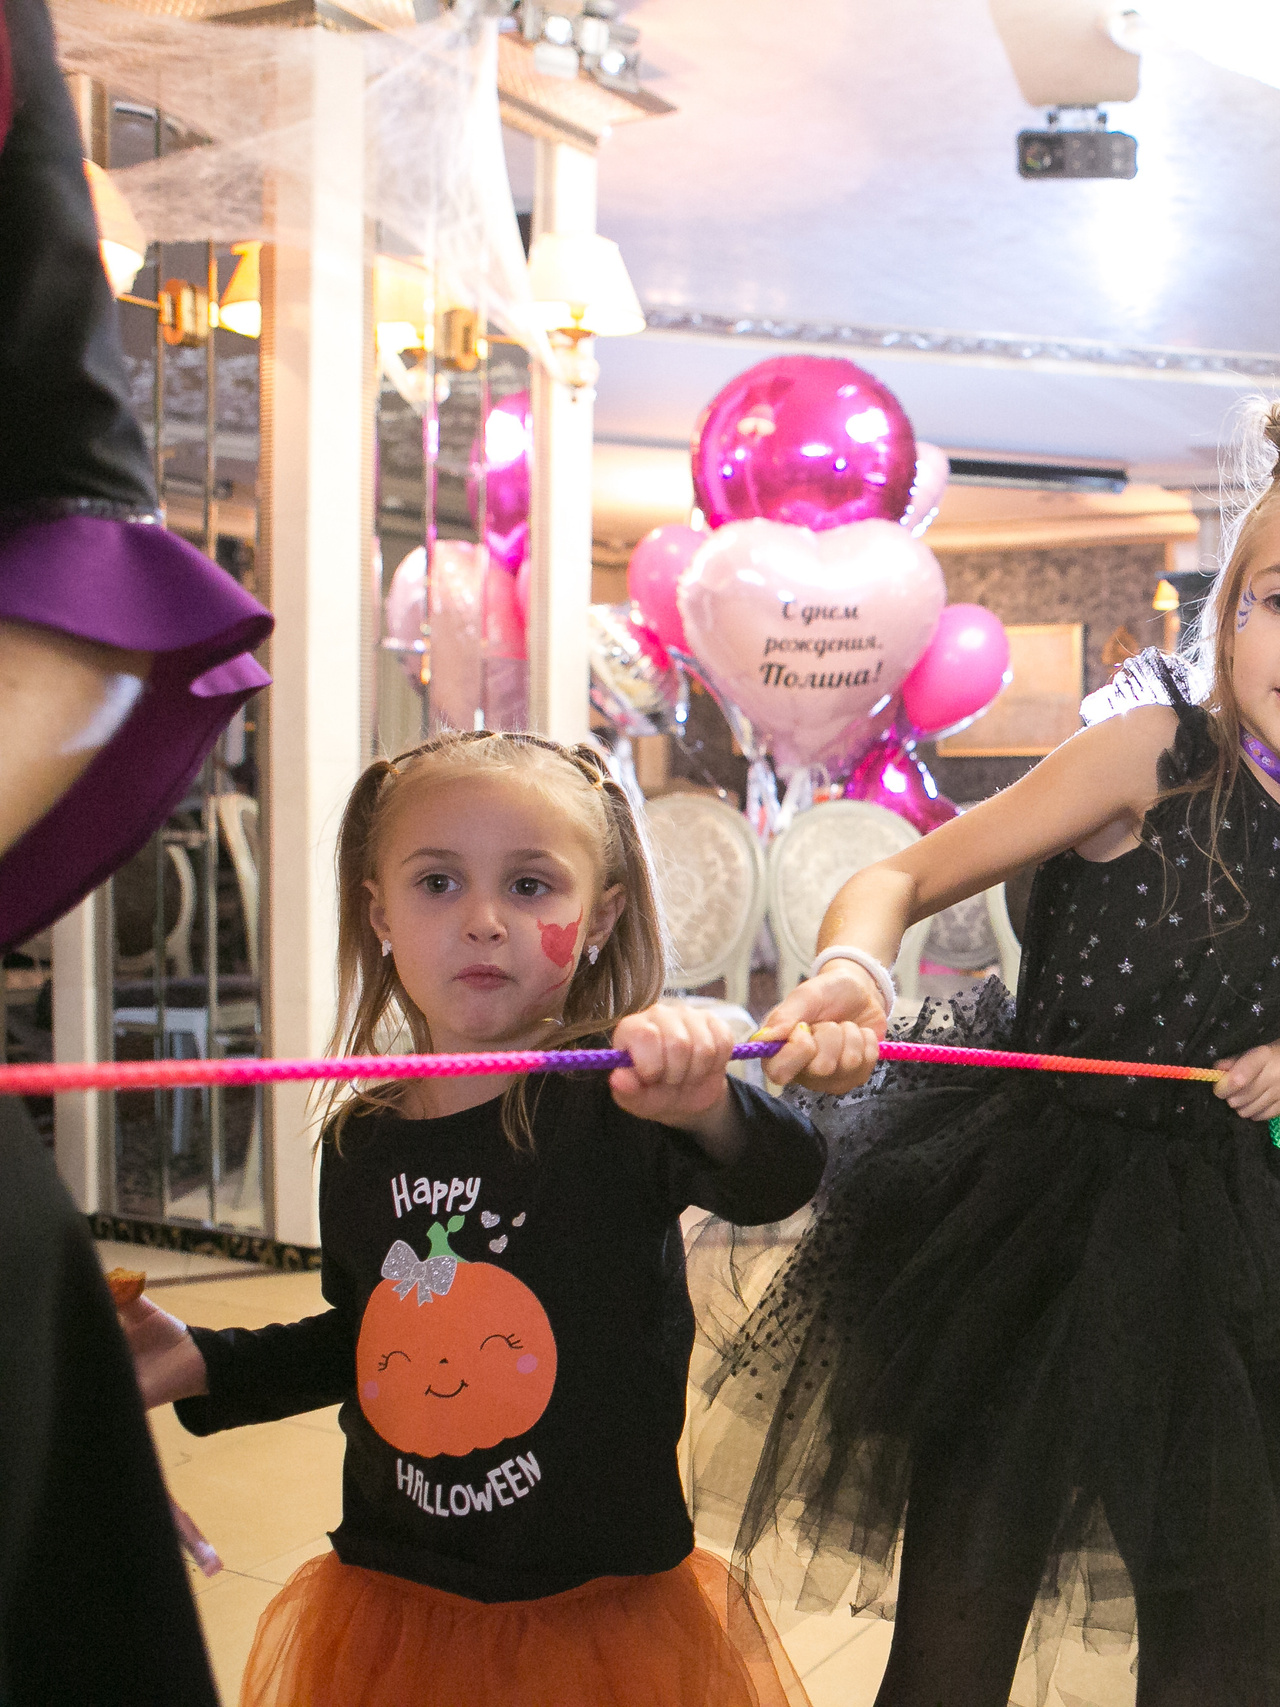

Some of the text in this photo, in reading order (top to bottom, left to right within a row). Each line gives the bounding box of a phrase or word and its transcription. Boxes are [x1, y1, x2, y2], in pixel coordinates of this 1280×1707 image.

[801, 606, 859, 626] днем
[759, 660, 884, 688] Полина!
[391, 1172, 481, 1219] Happy
[396, 1451, 542, 1517] HALLOWEEN
